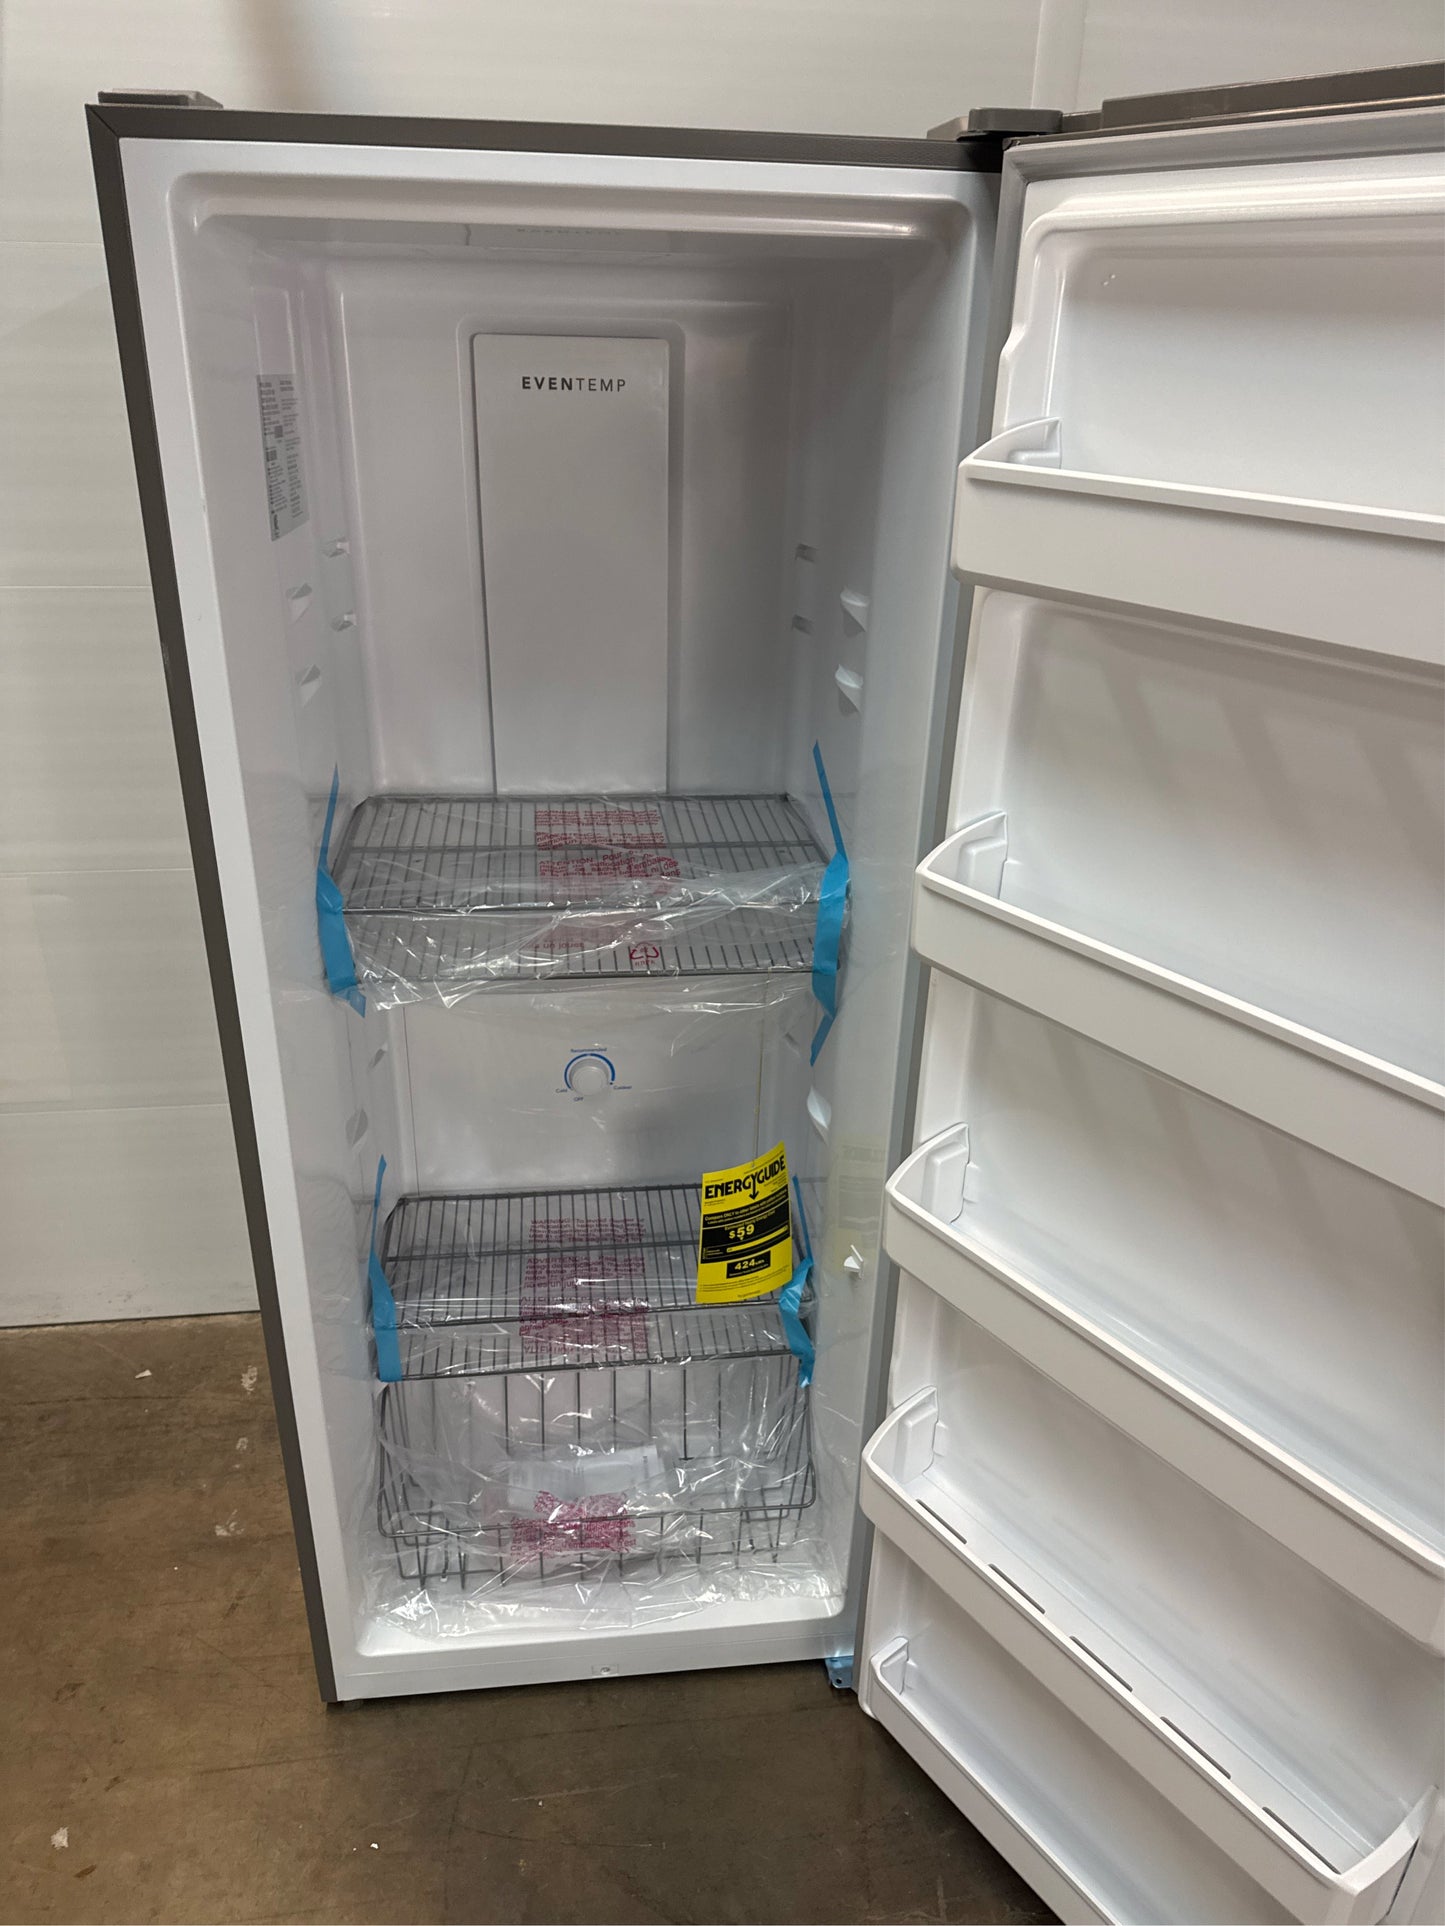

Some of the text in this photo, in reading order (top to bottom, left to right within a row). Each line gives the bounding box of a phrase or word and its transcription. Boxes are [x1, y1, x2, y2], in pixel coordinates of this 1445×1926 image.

[521, 376, 626, 392] EVENTEMP
[728, 1223, 755, 1239] $59
[734, 1258, 755, 1270] 424
